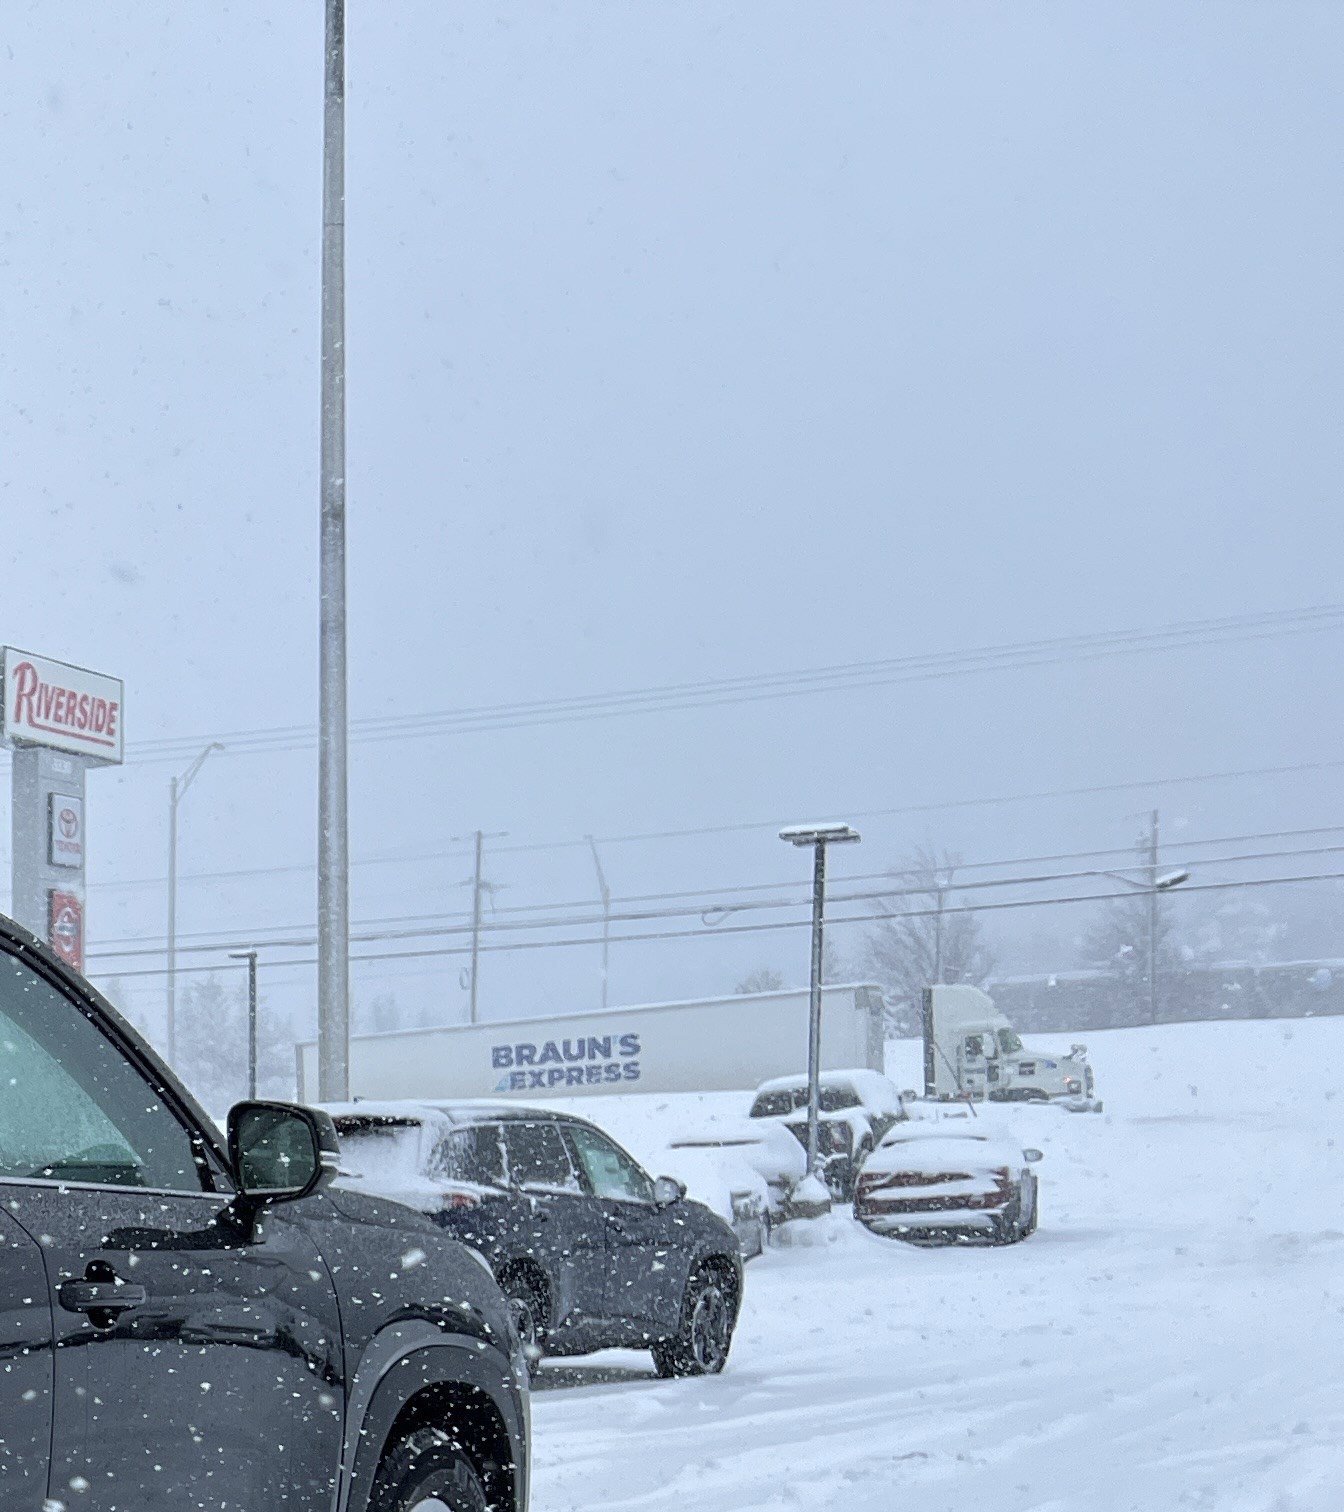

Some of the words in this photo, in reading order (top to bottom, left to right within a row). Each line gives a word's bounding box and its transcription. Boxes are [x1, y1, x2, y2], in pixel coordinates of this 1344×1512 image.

[13, 661, 118, 746] RIVERSIDE
[491, 1033, 641, 1069] BRAUN'S
[509, 1061, 641, 1090] EXPRESS
